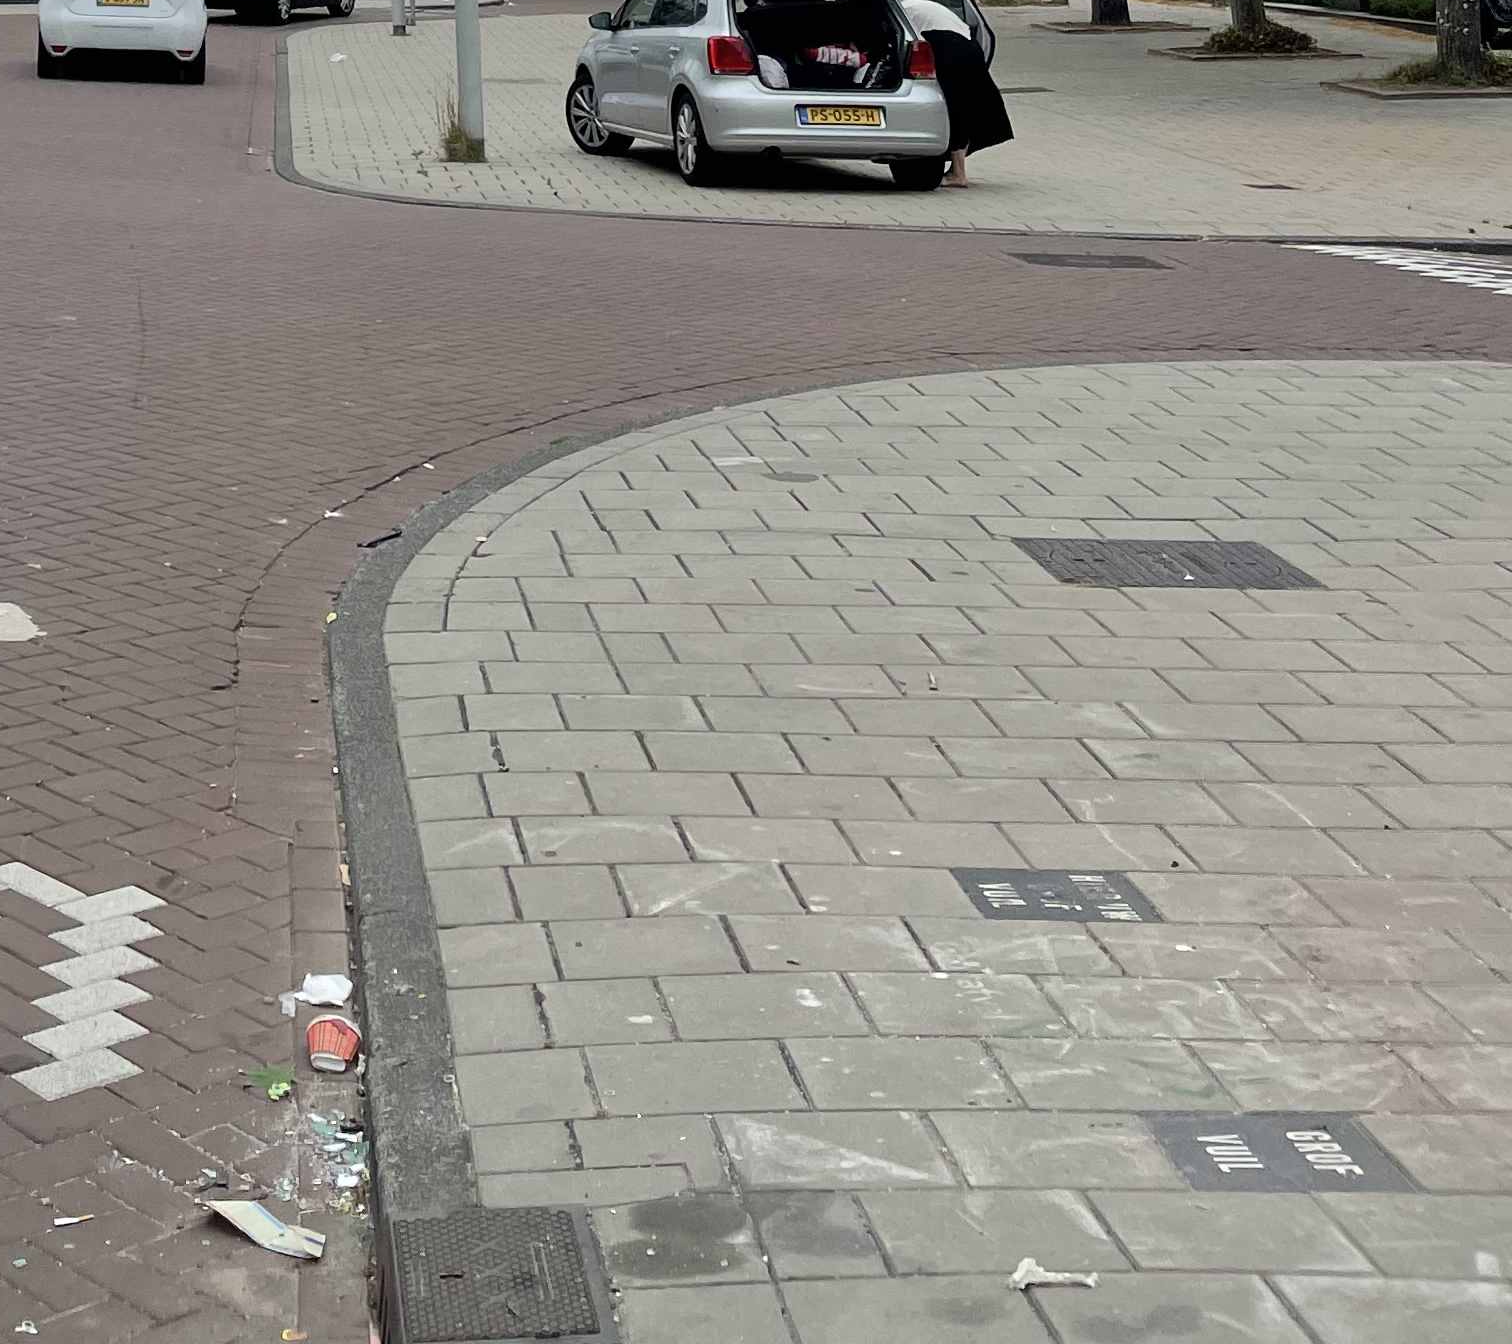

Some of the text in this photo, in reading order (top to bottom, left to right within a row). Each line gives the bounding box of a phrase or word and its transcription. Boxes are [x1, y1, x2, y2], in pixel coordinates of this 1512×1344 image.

[810, 108, 875, 123] PS-055-H
[1196, 1134, 1265, 1173] VUIL
[1285, 1130, 1365, 1176] GROF
